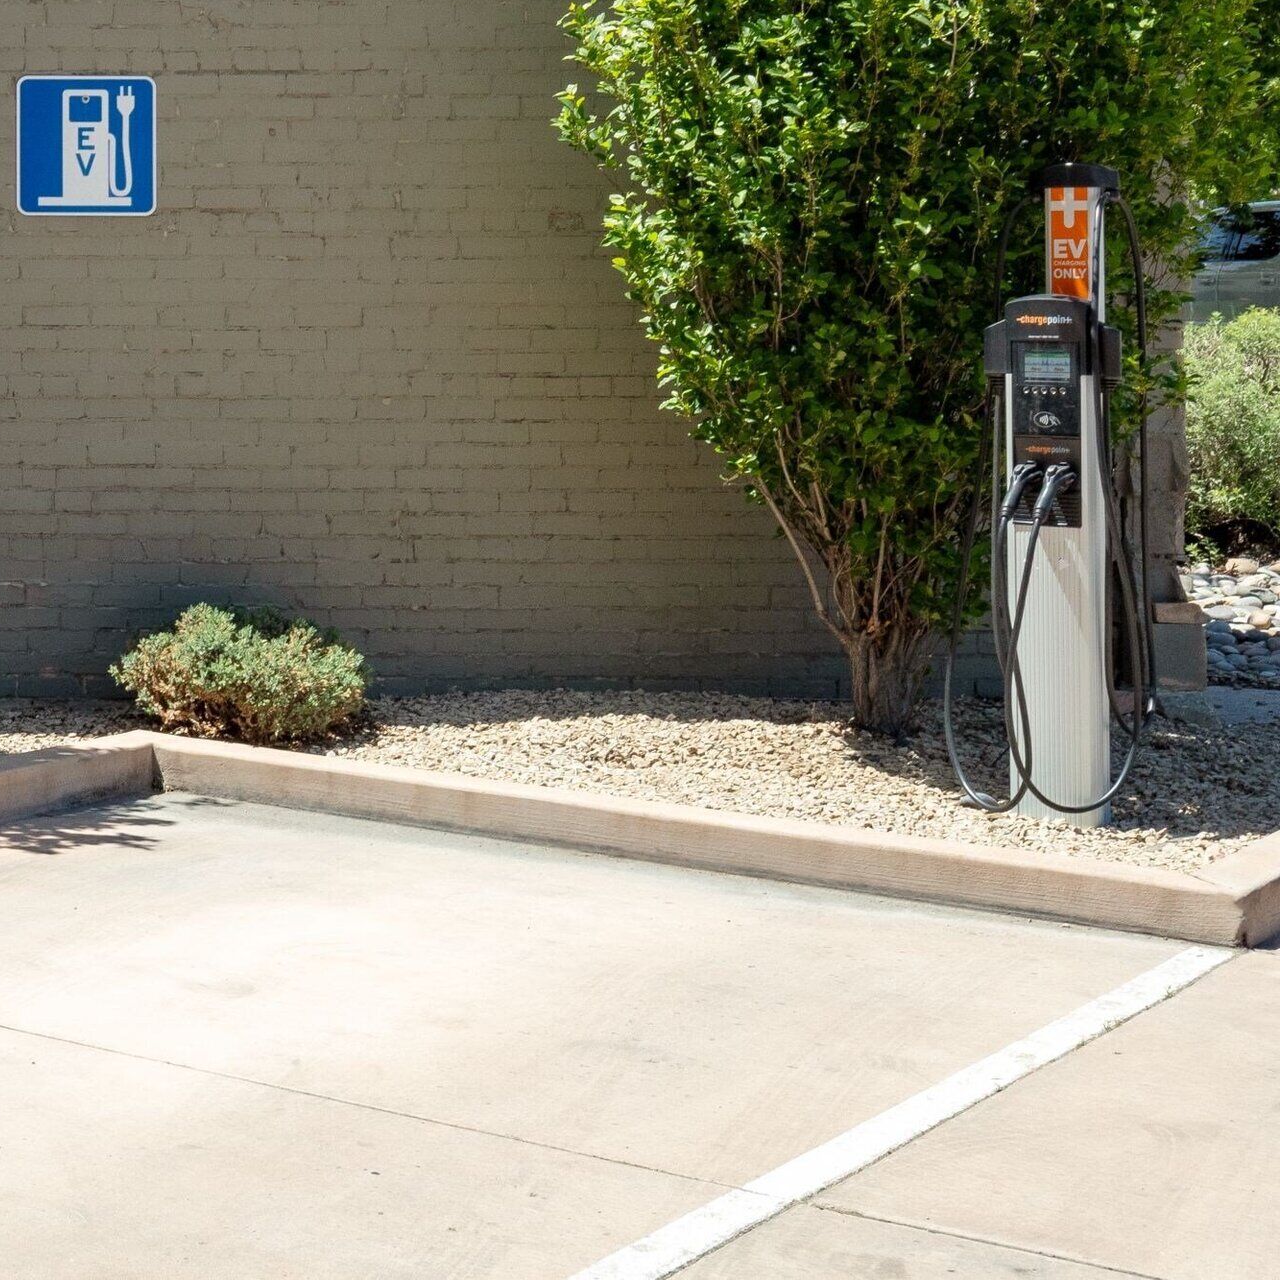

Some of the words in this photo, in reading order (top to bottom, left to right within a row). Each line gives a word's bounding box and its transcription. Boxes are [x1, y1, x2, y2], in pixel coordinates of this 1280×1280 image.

[75, 126, 96, 176] EV
[1053, 238, 1087, 259] EV
[1053, 268, 1087, 279] ONLY
